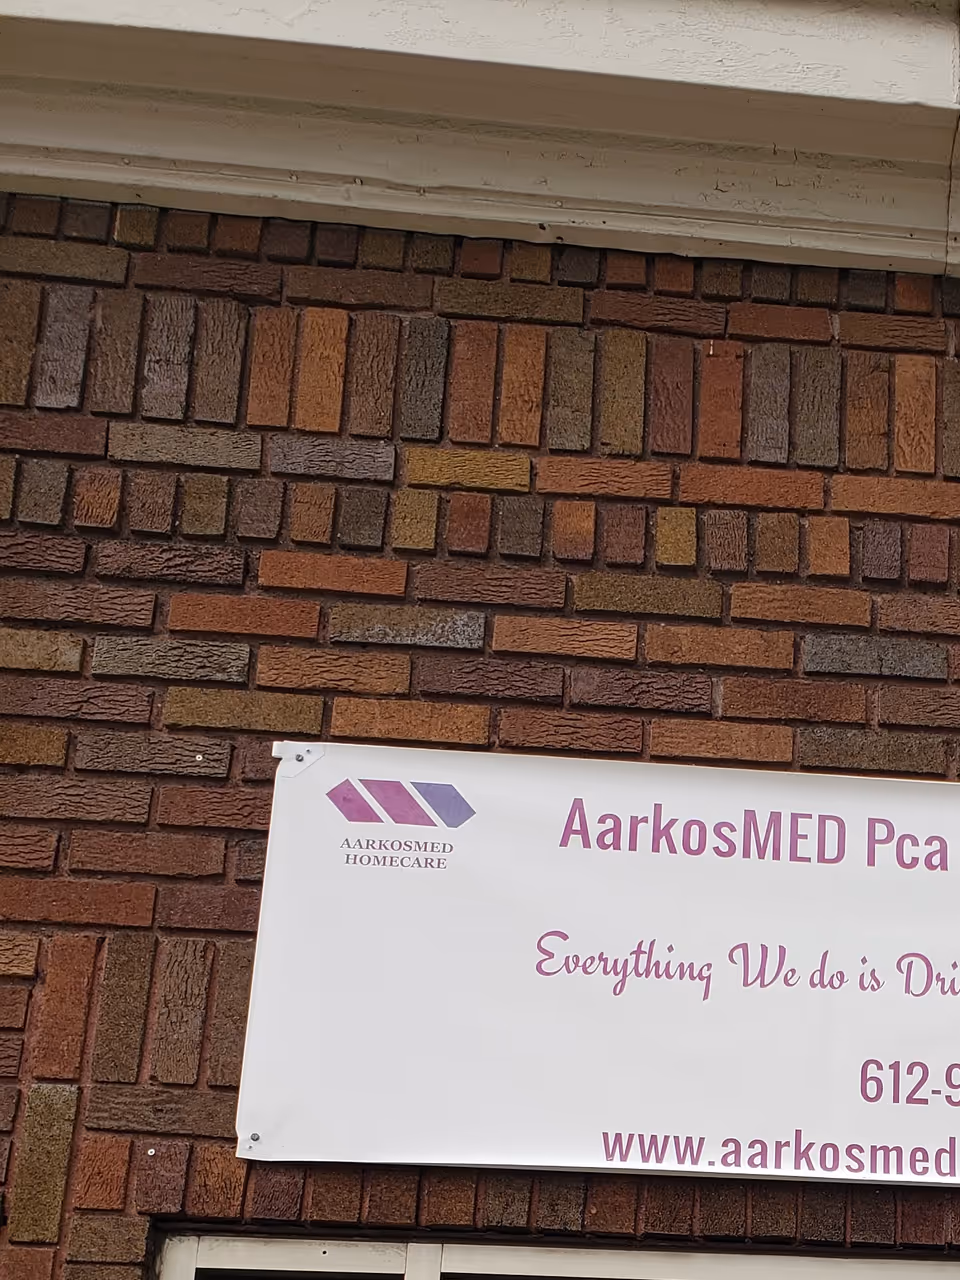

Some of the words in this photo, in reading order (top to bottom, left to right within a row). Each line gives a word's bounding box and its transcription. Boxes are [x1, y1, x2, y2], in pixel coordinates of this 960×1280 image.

[339, 837, 454, 854] AARKOSMED
[559, 797, 847, 865] AarkosMED
[866, 817, 949, 872] Pca
[344, 853, 448, 870] HOMECARE
[535, 930, 712, 1001] Everything
[728, 943, 801, 989] We
[809, 950, 848, 992] do
[859, 956, 885, 992] is
